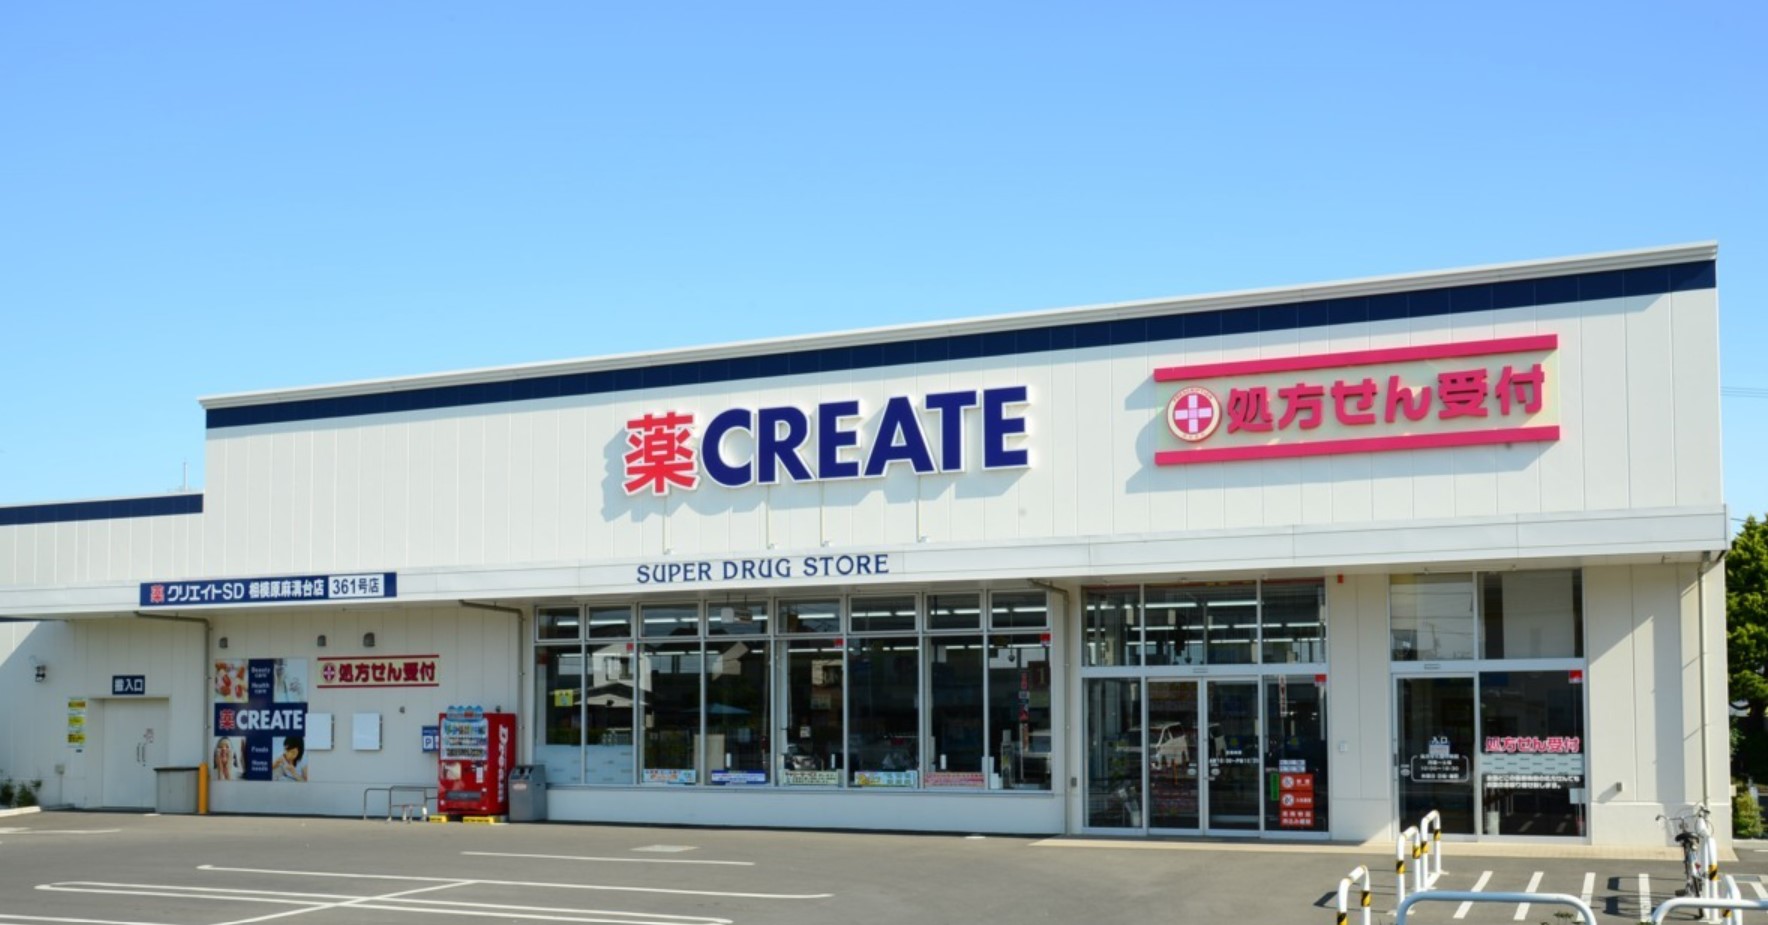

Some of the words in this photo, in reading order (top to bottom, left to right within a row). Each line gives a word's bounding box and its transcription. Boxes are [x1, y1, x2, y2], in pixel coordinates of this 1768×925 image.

[1227, 364, 1546, 433] 処方せん受付
[623, 410, 698, 495] 薬
[701, 385, 1029, 487] CREATE
[636, 561, 713, 584] SUPER
[722, 558, 792, 580] DRUG
[802, 553, 890, 577] STORE
[167, 582, 245, 602] クリエイトSD
[332, 577, 380, 595] 361号店
[339, 661, 436, 683] 処方せん受付
[236, 709, 303, 730] CREATE
[1485, 736, 1580, 753] 処方せん受付
